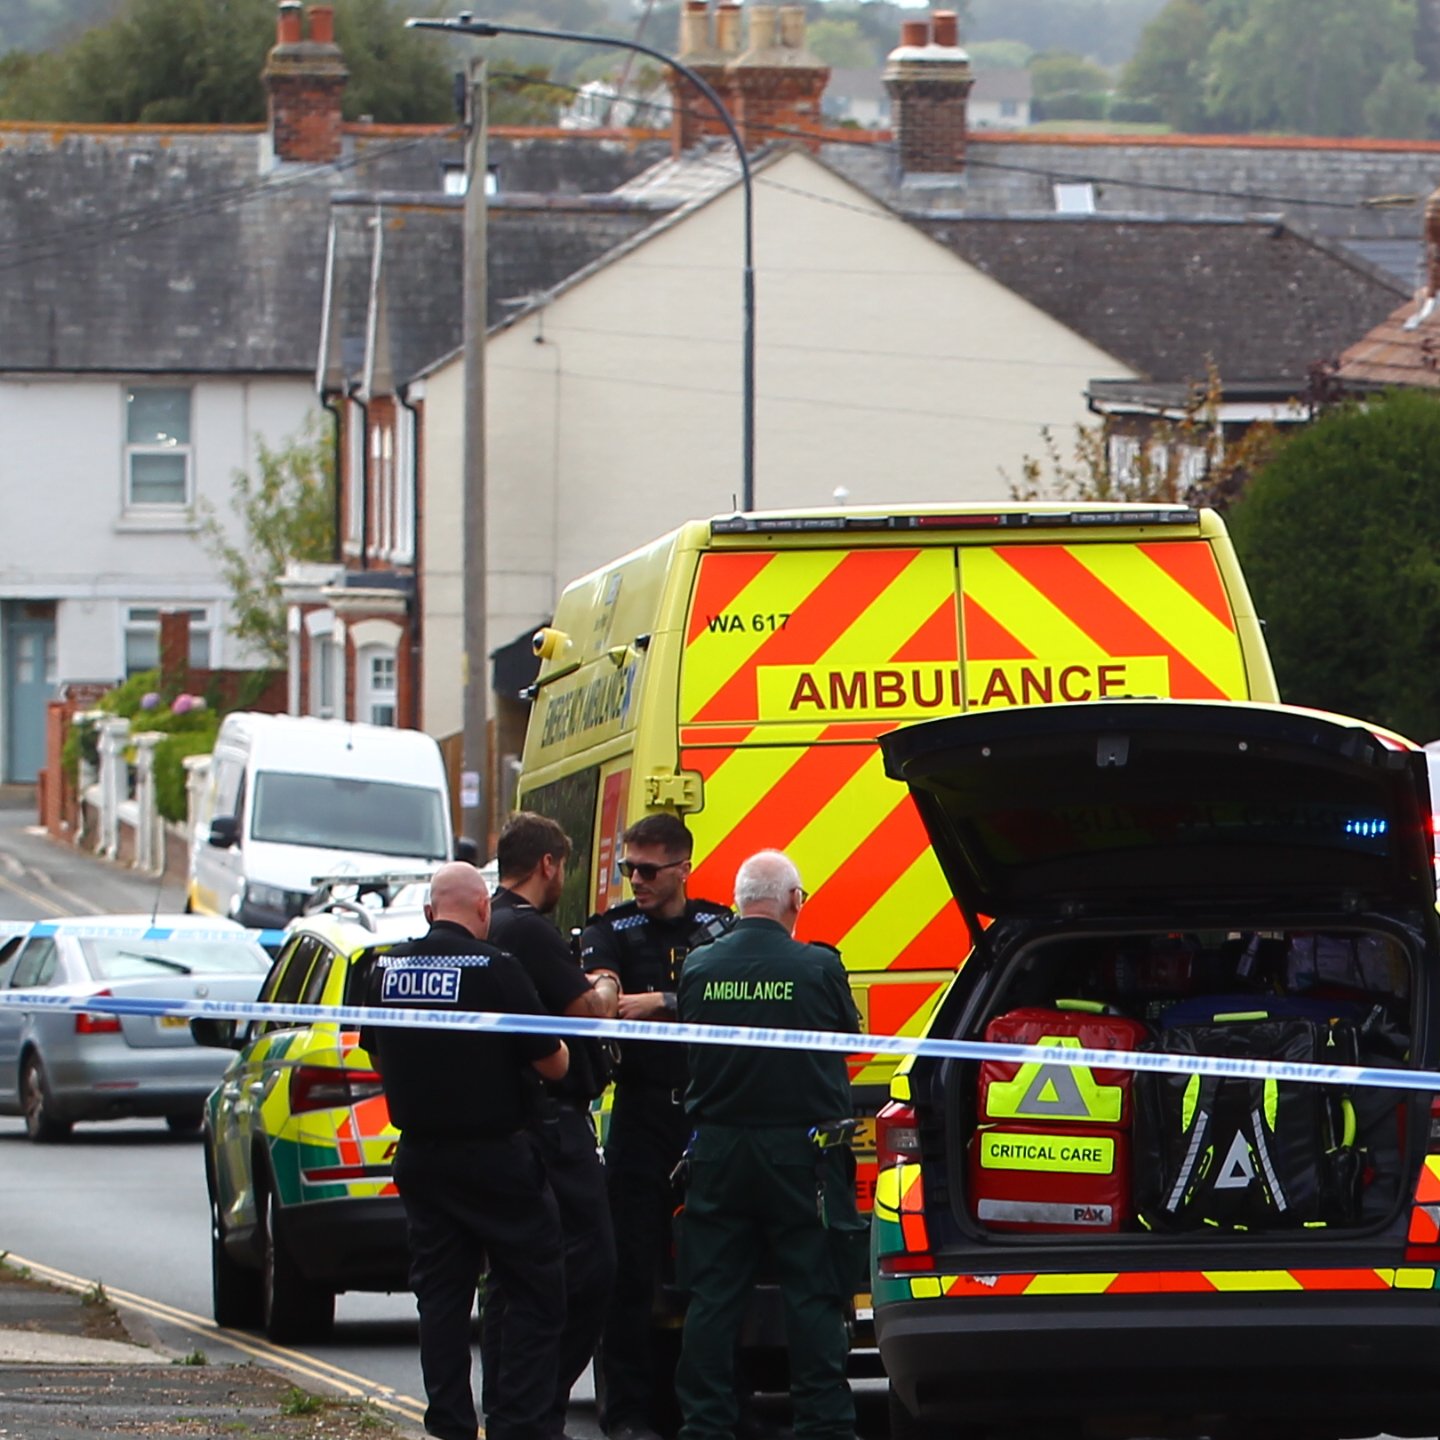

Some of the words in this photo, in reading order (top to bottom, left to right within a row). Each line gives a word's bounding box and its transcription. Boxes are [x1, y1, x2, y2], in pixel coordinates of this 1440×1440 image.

[706, 614, 746, 633] WA
[752, 613, 791, 632] 617
[788, 664, 1127, 711] AMBULANCE
[385, 969, 457, 997] POLICE
[703, 981, 794, 1001] AMBULANCE
[990, 1143, 1057, 1160] CRITICAL
[1060, 1147, 1103, 1162] CARE
[1074, 1206, 1105, 1222] PAX
